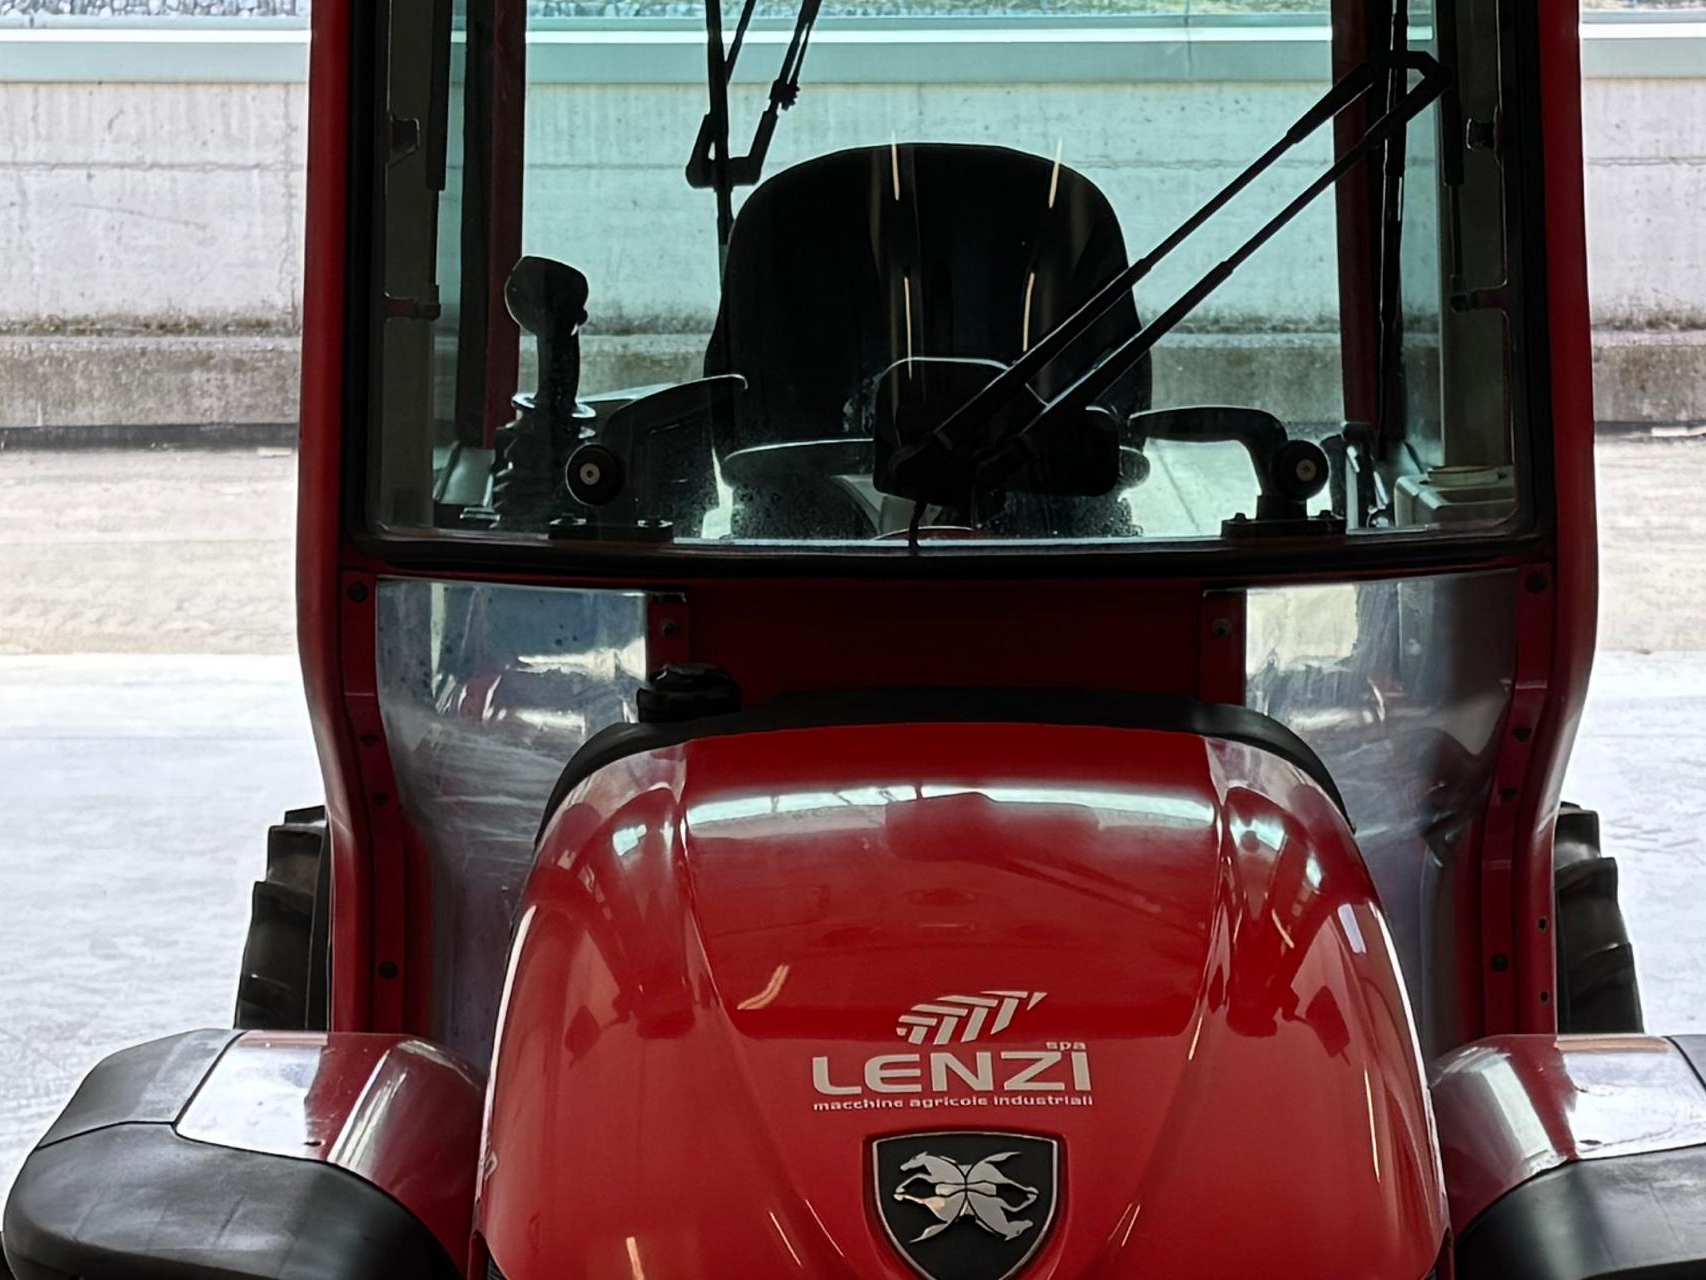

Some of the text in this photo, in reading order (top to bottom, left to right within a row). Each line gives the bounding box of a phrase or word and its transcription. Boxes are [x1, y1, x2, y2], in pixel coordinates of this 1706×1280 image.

[1045, 1041, 1087, 1051] spa
[812, 1051, 1092, 1096] LENZI
[813, 1095, 1093, 1111] macchine agricole industriali
